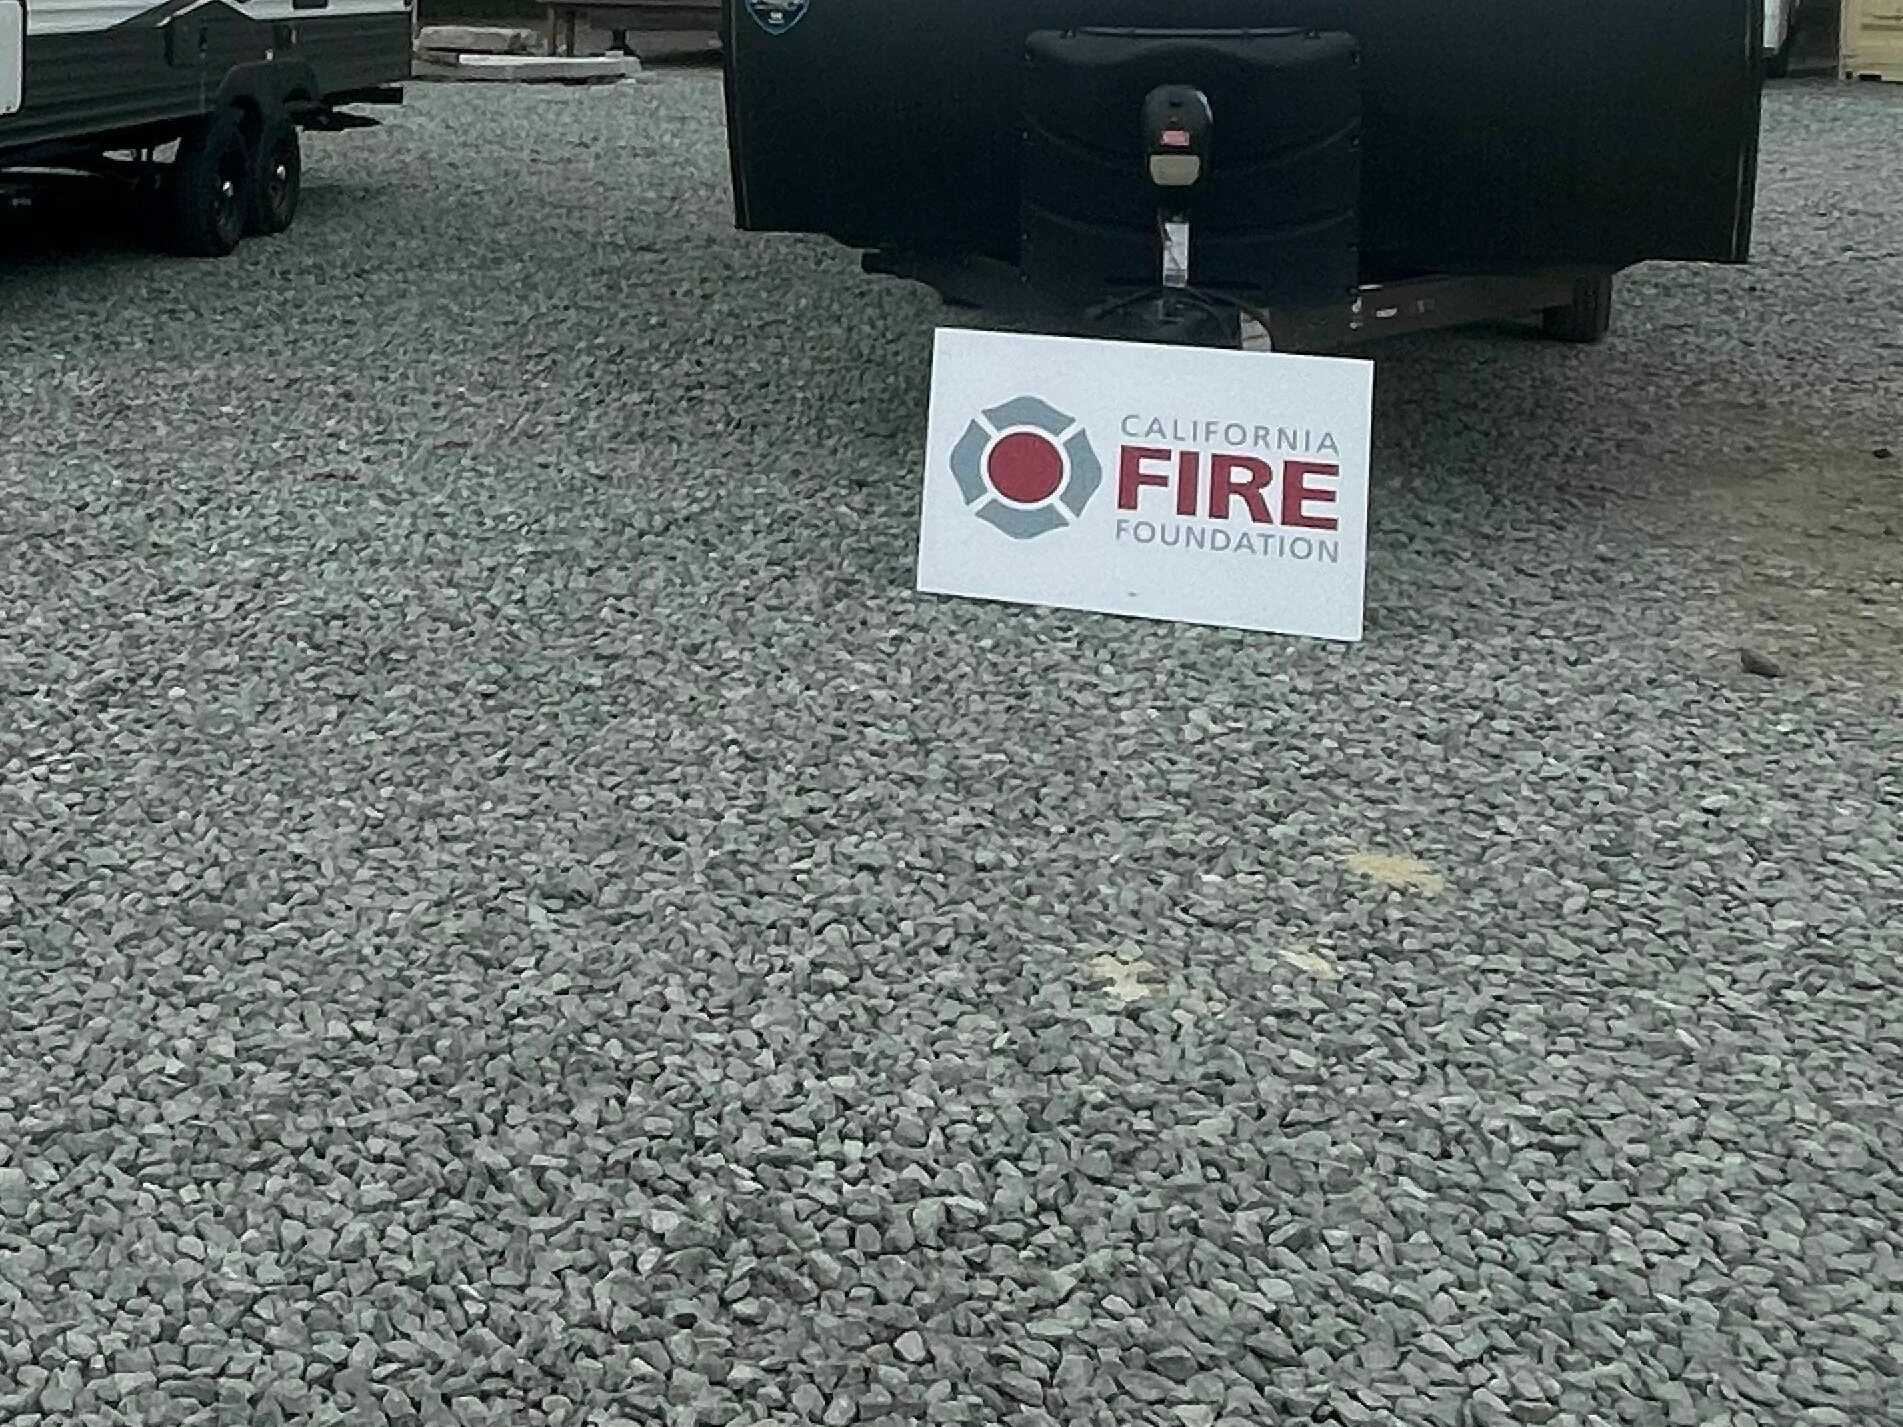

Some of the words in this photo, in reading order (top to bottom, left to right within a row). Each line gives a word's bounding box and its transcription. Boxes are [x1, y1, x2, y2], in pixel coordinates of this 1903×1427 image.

[1120, 414, 1339, 456] CALIFORNIA
[1118, 444, 1339, 531] FIRE
[1115, 518, 1339, 563] FOUNDATION
